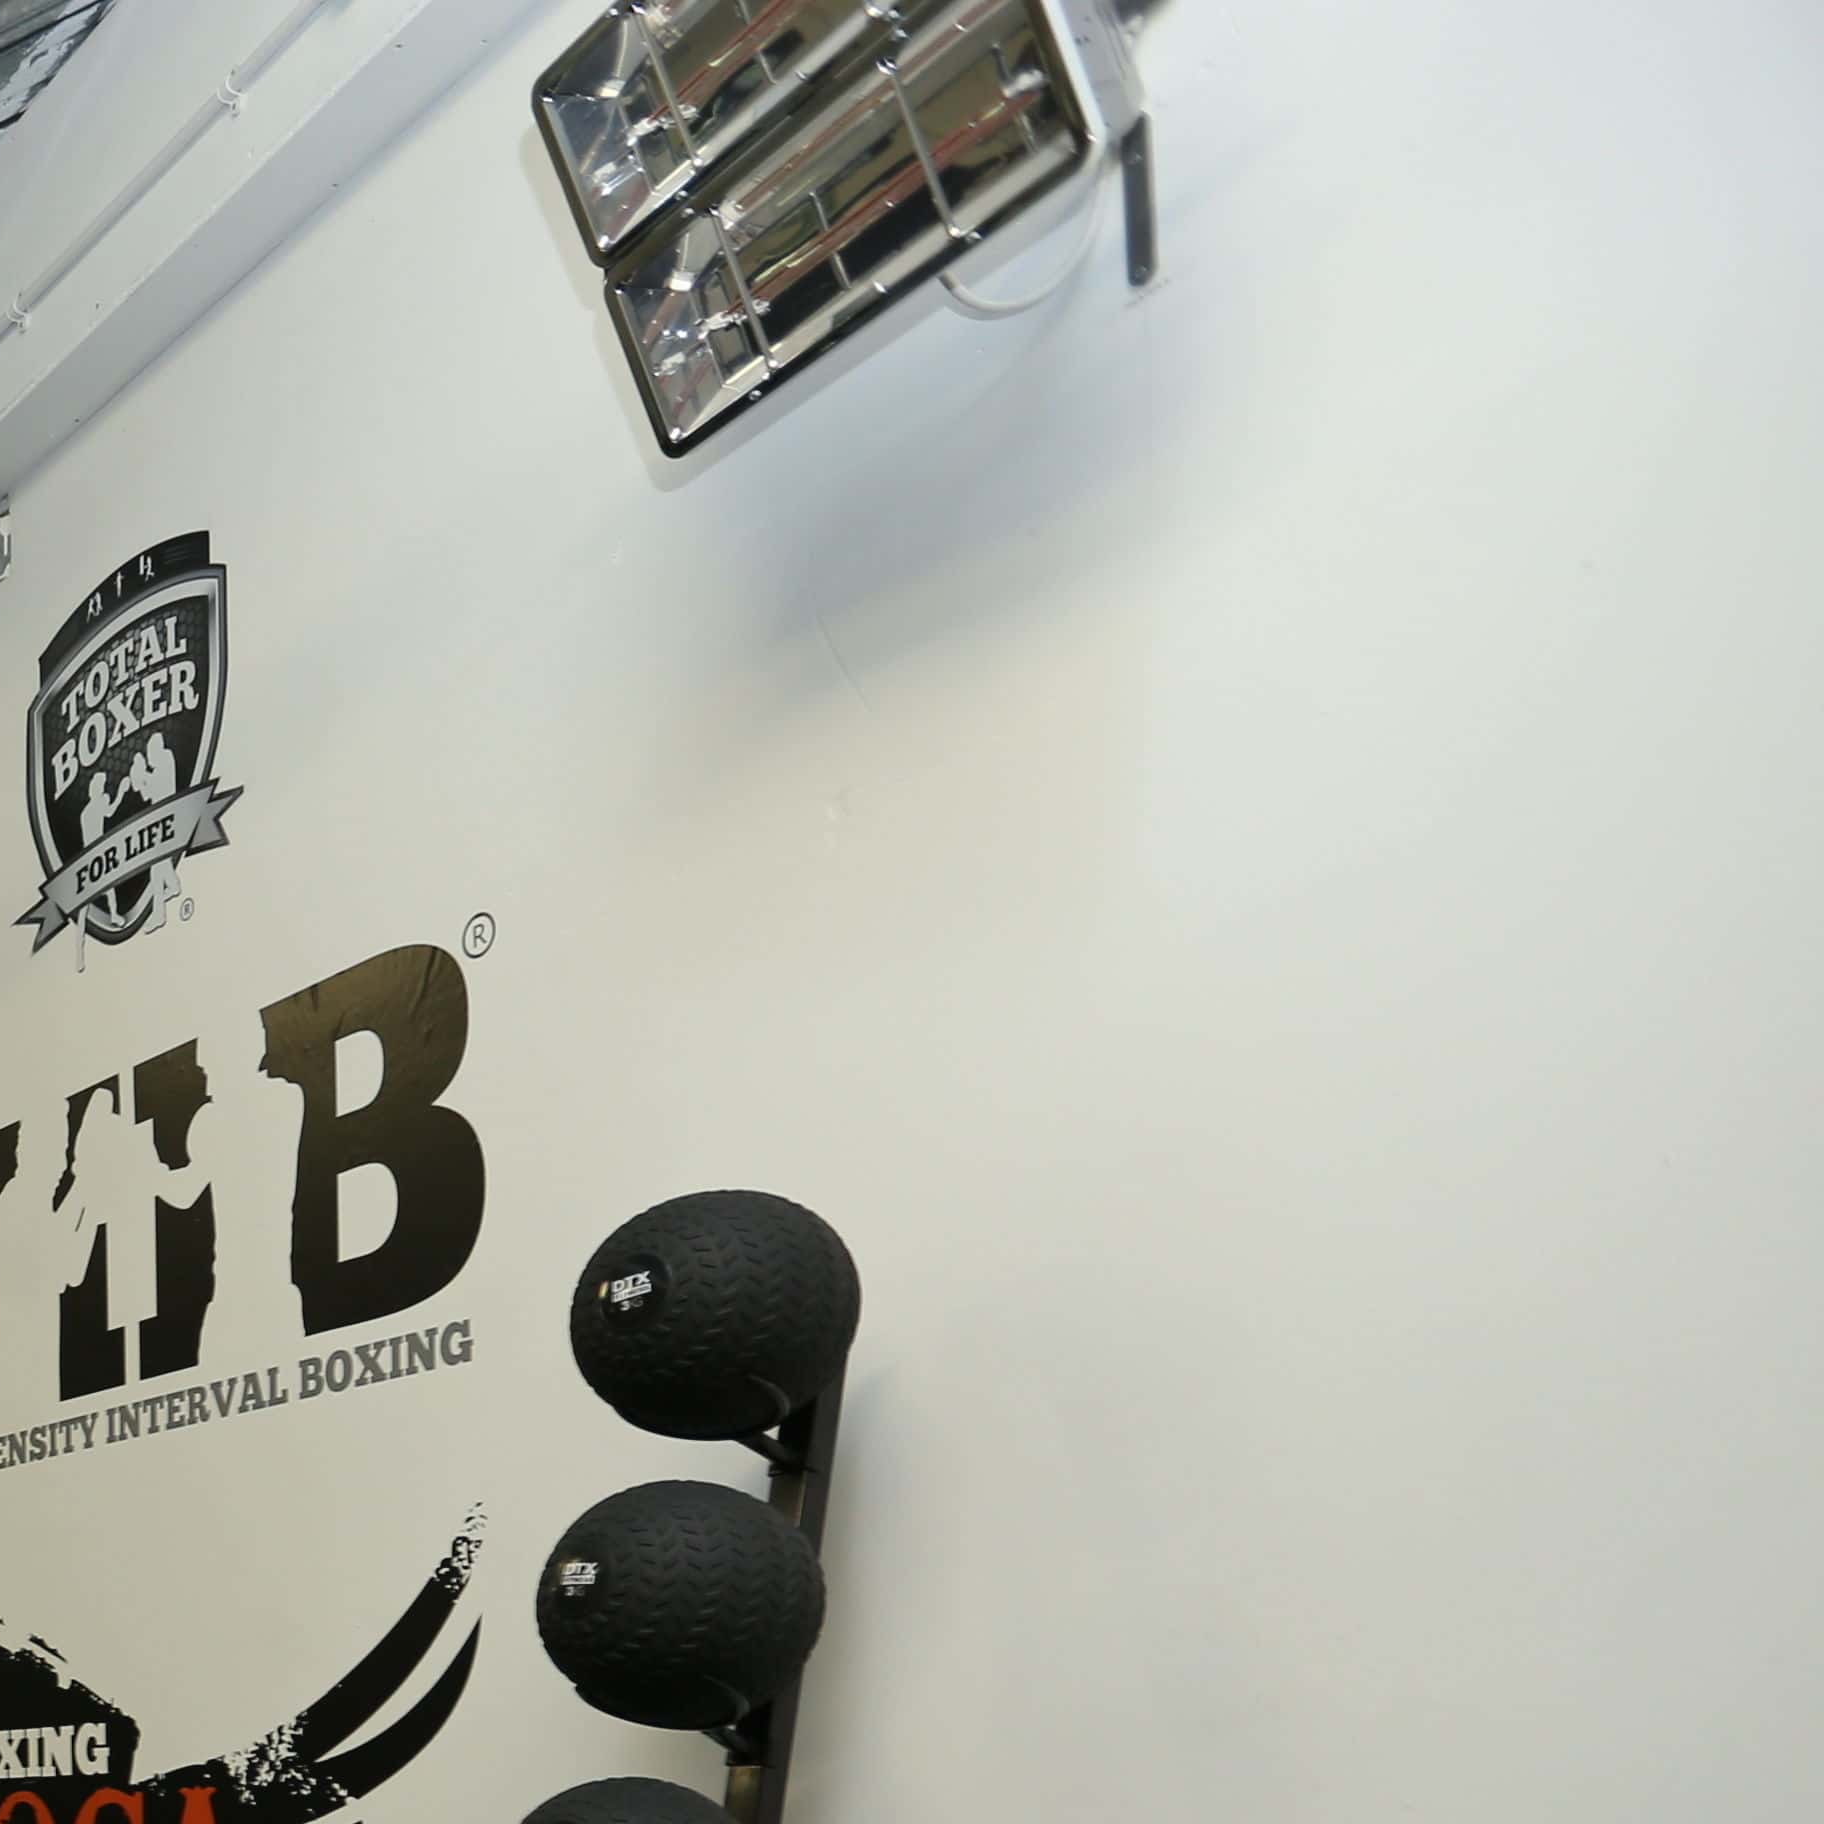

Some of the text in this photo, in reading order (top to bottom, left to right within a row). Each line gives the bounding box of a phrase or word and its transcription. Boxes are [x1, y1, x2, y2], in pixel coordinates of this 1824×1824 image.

[61, 616, 187, 734] TOTAL
[52, 660, 200, 801] BOXER
[75, 814, 176, 895] FOR LIFE
[611, 1270, 651, 1293] DTX
[106, 1367, 289, 1444] INTERVAL
[299, 1319, 474, 1400] BOXING
[561, 1562, 599, 1576] DTX
